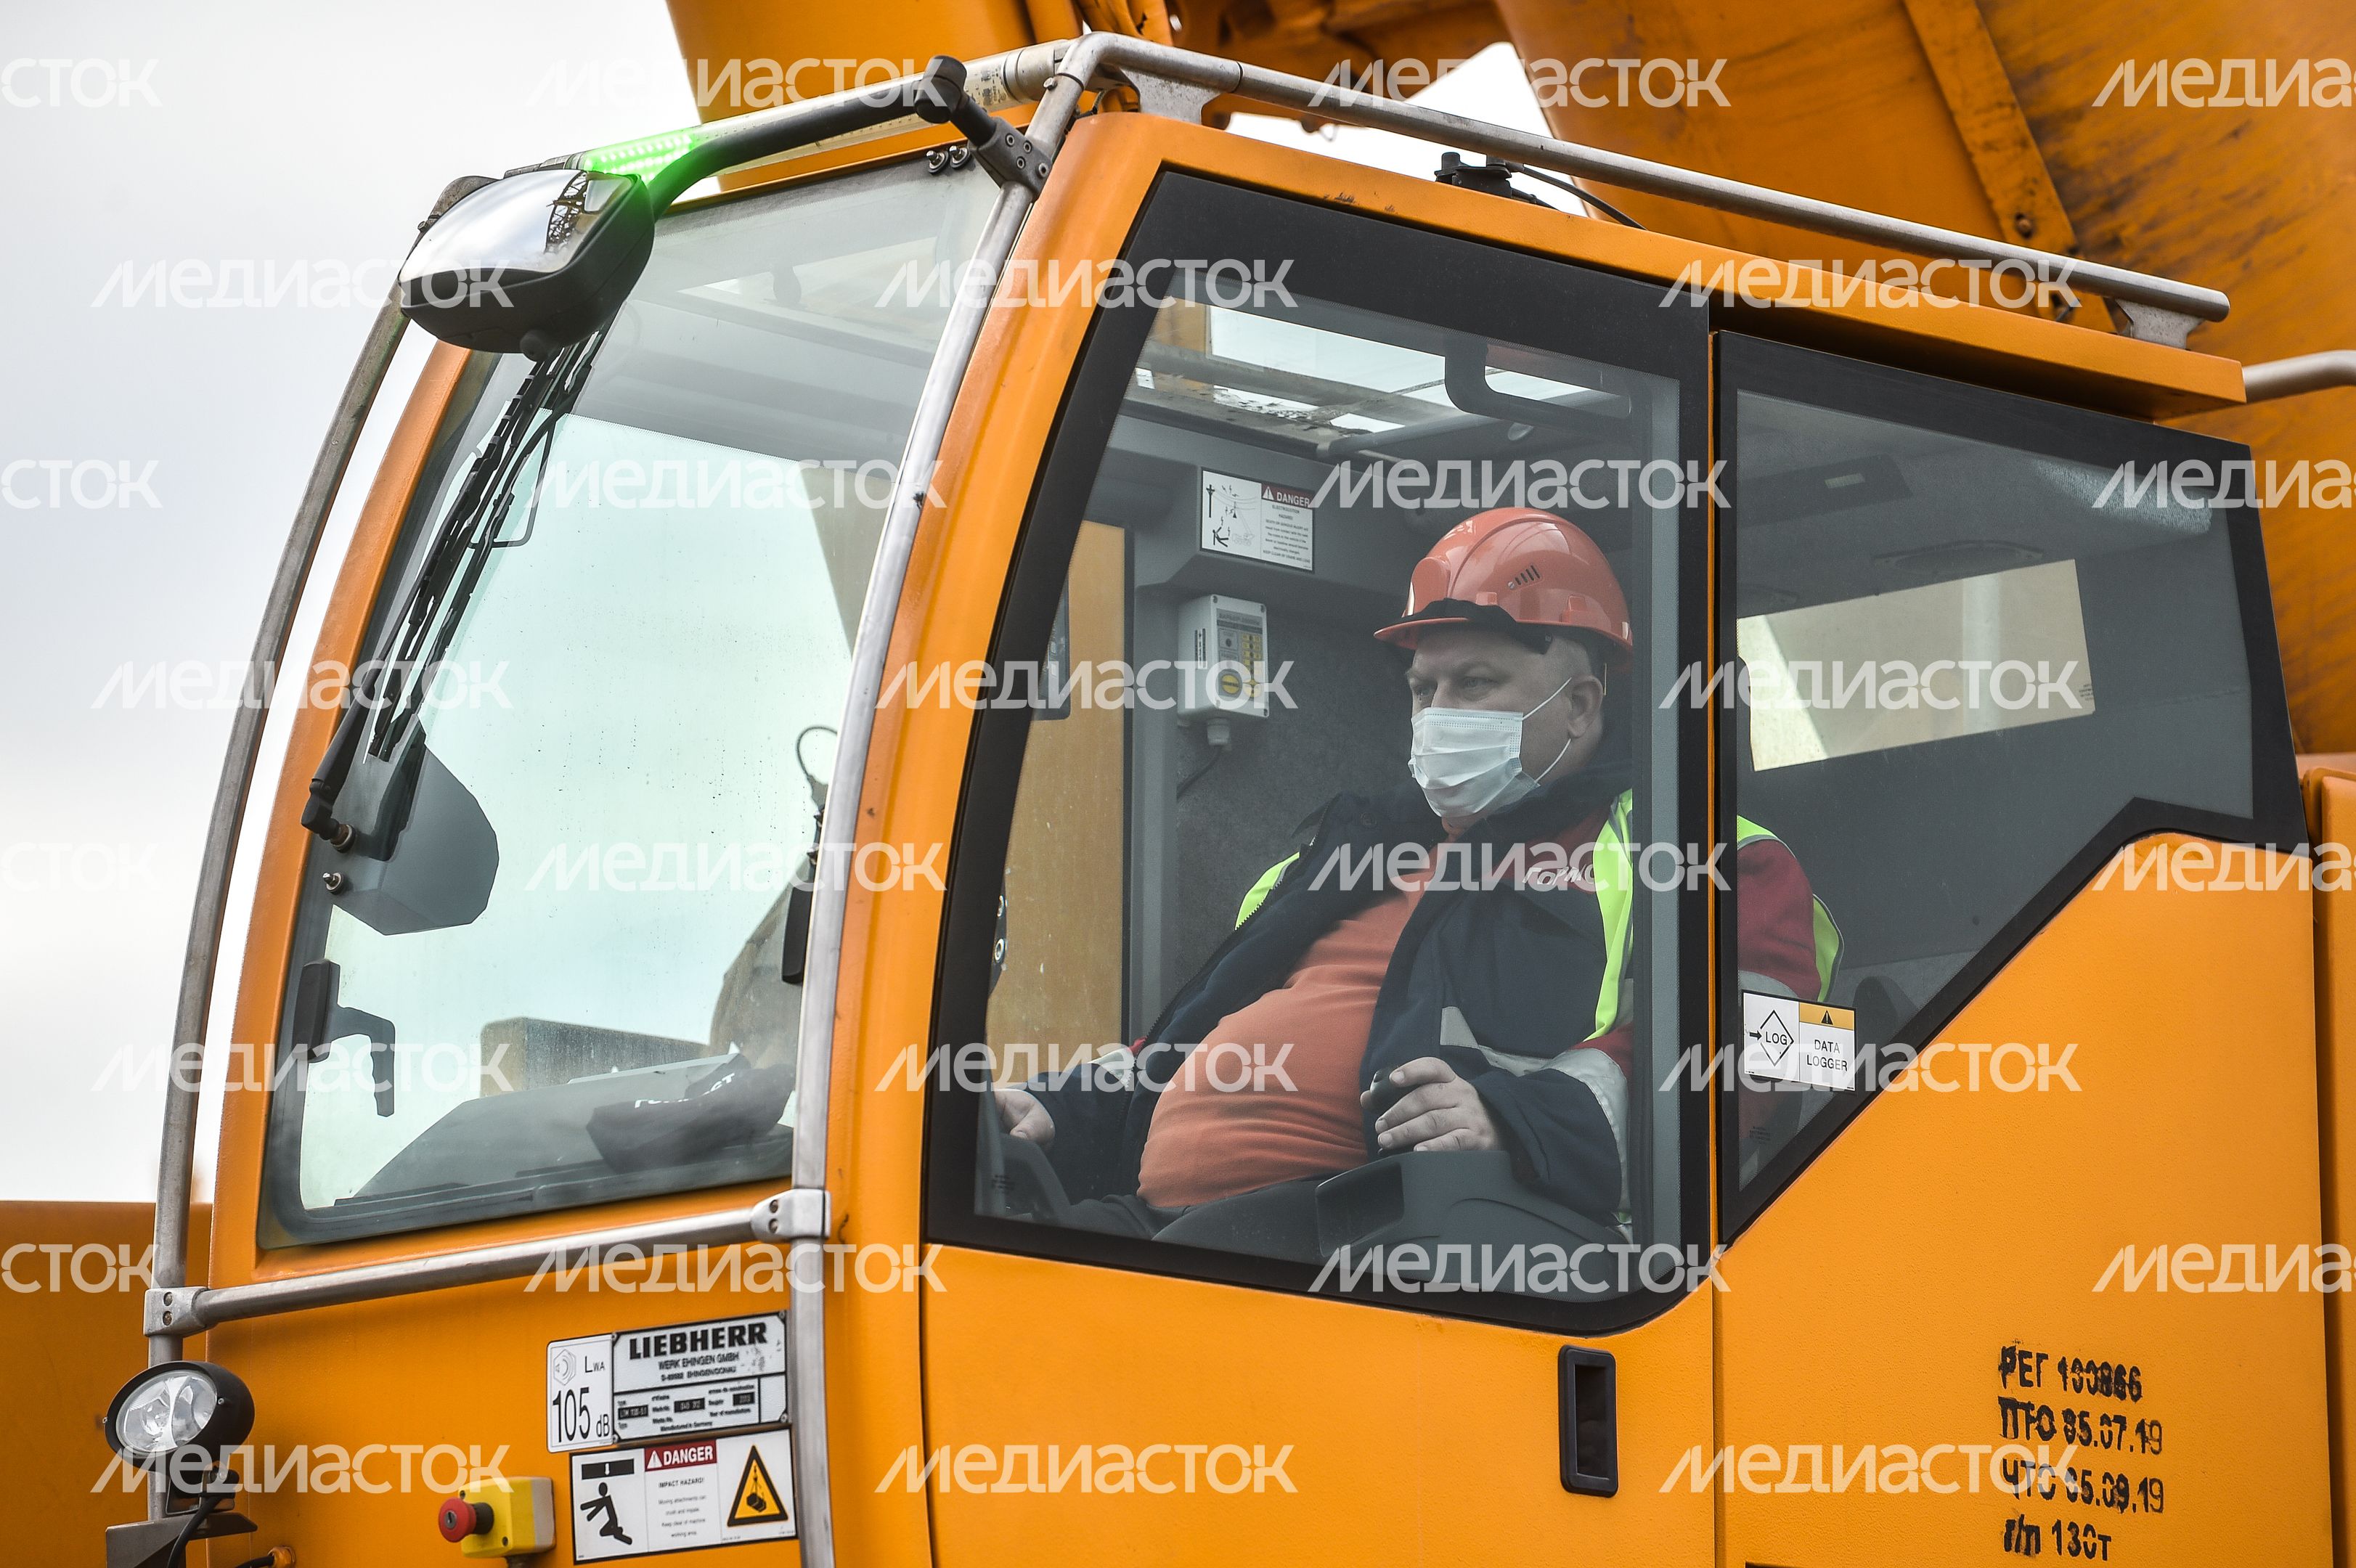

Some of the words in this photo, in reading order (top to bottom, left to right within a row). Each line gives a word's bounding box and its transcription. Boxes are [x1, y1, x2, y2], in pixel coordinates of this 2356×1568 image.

[1276, 491, 1310, 508] DANGER
[1765, 1031, 1788, 1045] LOG
[1814, 1039, 1841, 1053] DATA
[1806, 1054, 1848, 1072] LOGGER
[629, 1322, 767, 1360] LIEBHERR
[1998, 1345, 2049, 1389] РЕГ
[553, 1387, 590, 1442] 105
[596, 1414, 610, 1437] dB
[663, 1445, 713, 1466] DANGER
